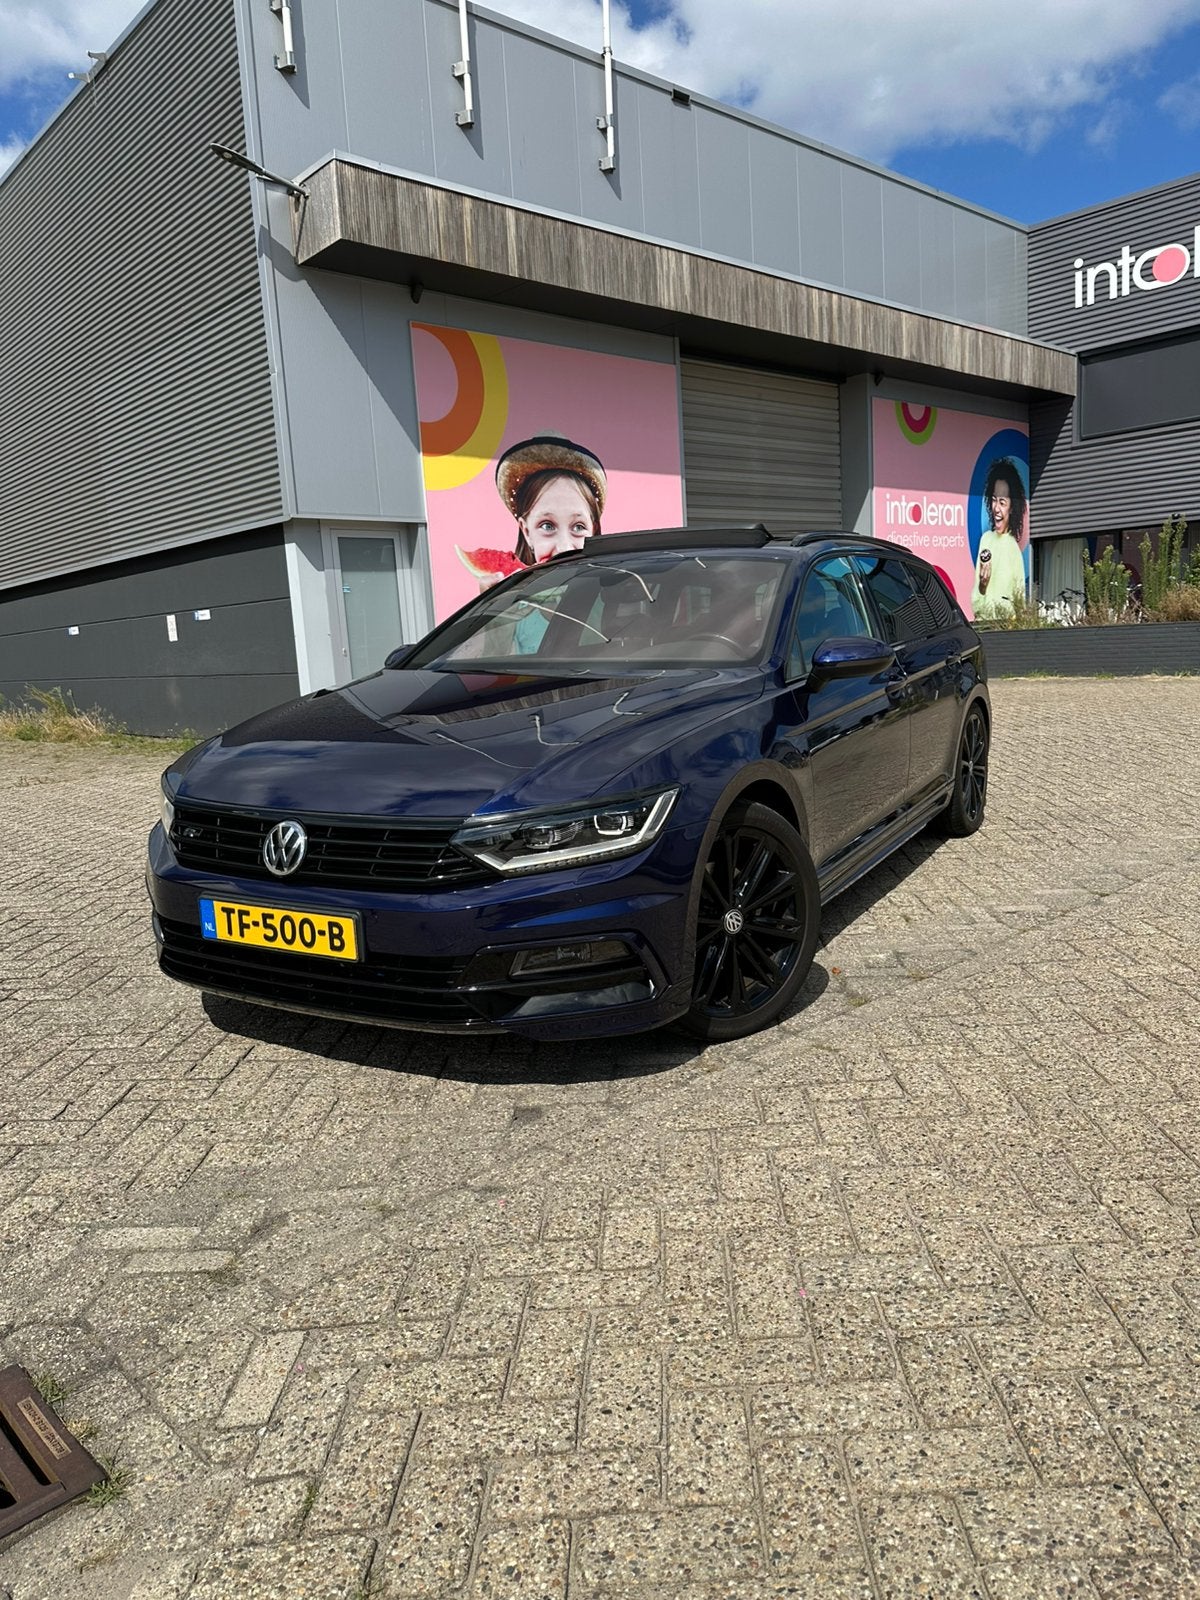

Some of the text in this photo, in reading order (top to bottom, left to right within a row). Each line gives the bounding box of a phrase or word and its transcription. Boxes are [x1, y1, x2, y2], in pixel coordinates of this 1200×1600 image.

[886, 493, 964, 526] intoleran
[932, 533, 964, 550] experts
[205, 922, 216, 932] NL
[221, 906, 346, 953] TF-500-B
